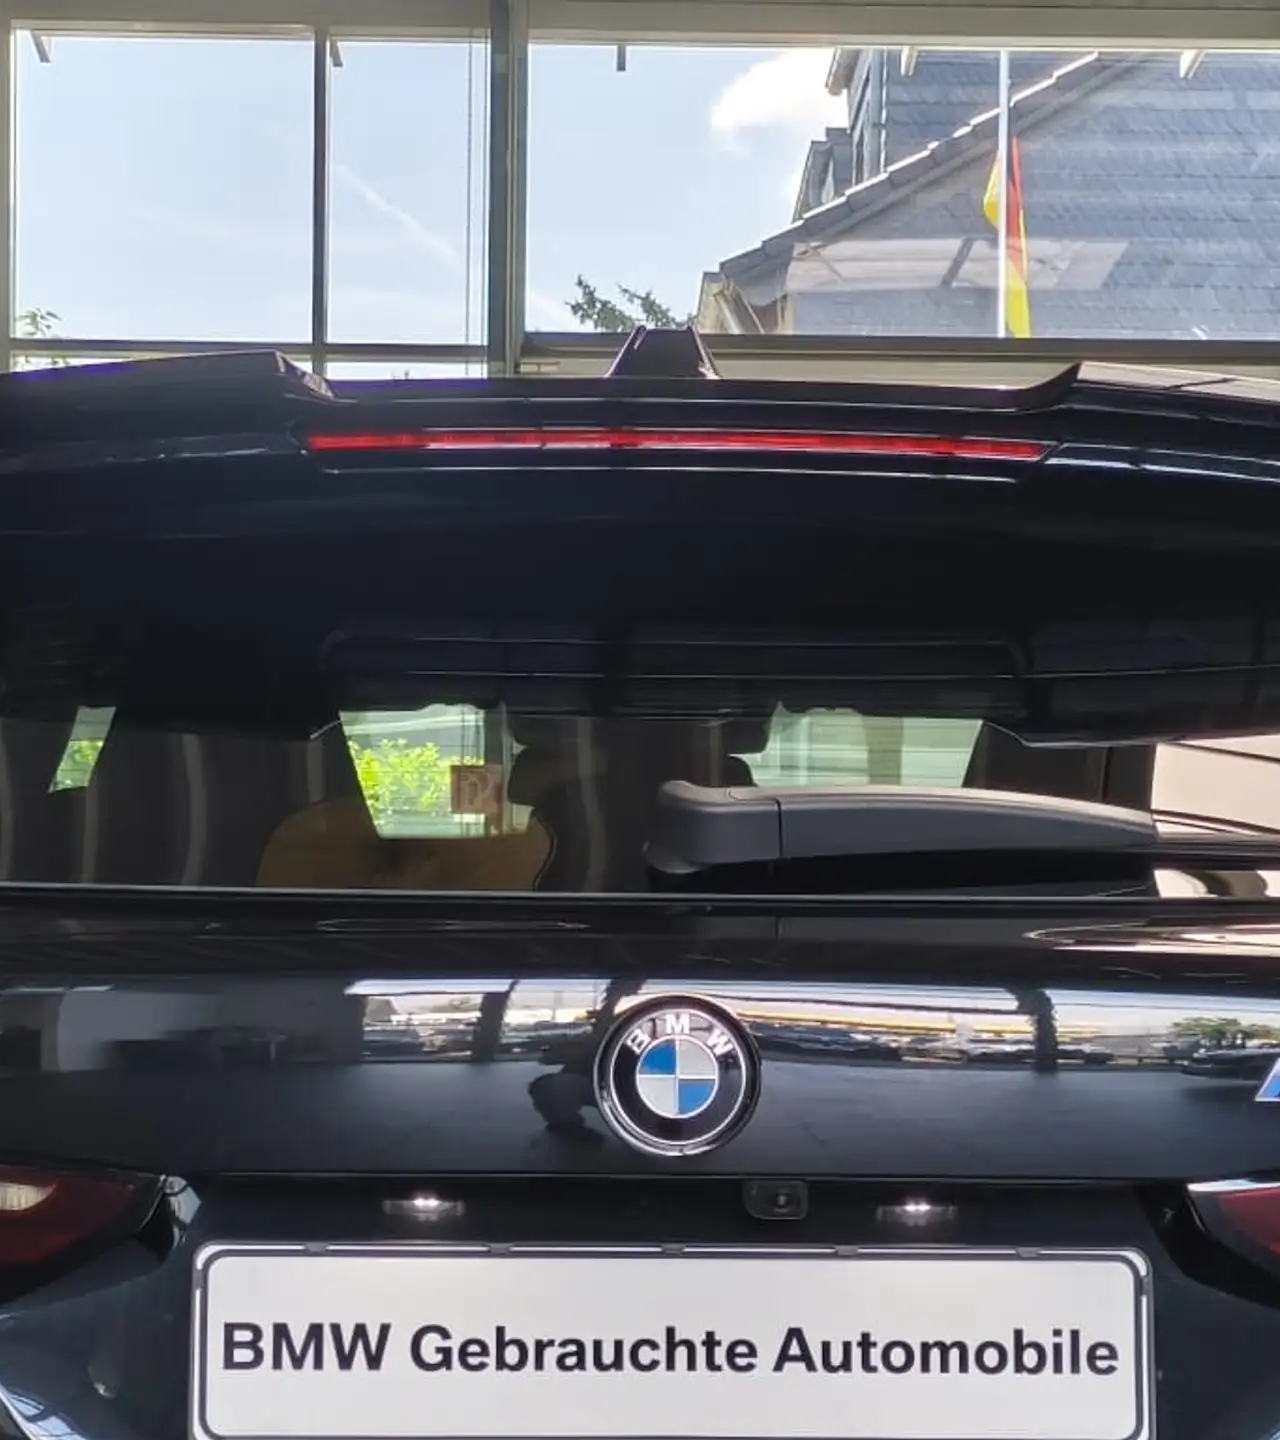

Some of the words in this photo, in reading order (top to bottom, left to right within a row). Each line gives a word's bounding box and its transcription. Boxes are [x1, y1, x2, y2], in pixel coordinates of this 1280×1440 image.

[626, 1012, 734, 1056] BMW
[222, 1322, 392, 1372] BMW
[410, 1324, 758, 1373] Gebrauchte
[772, 1327, 1119, 1376] Automobile
